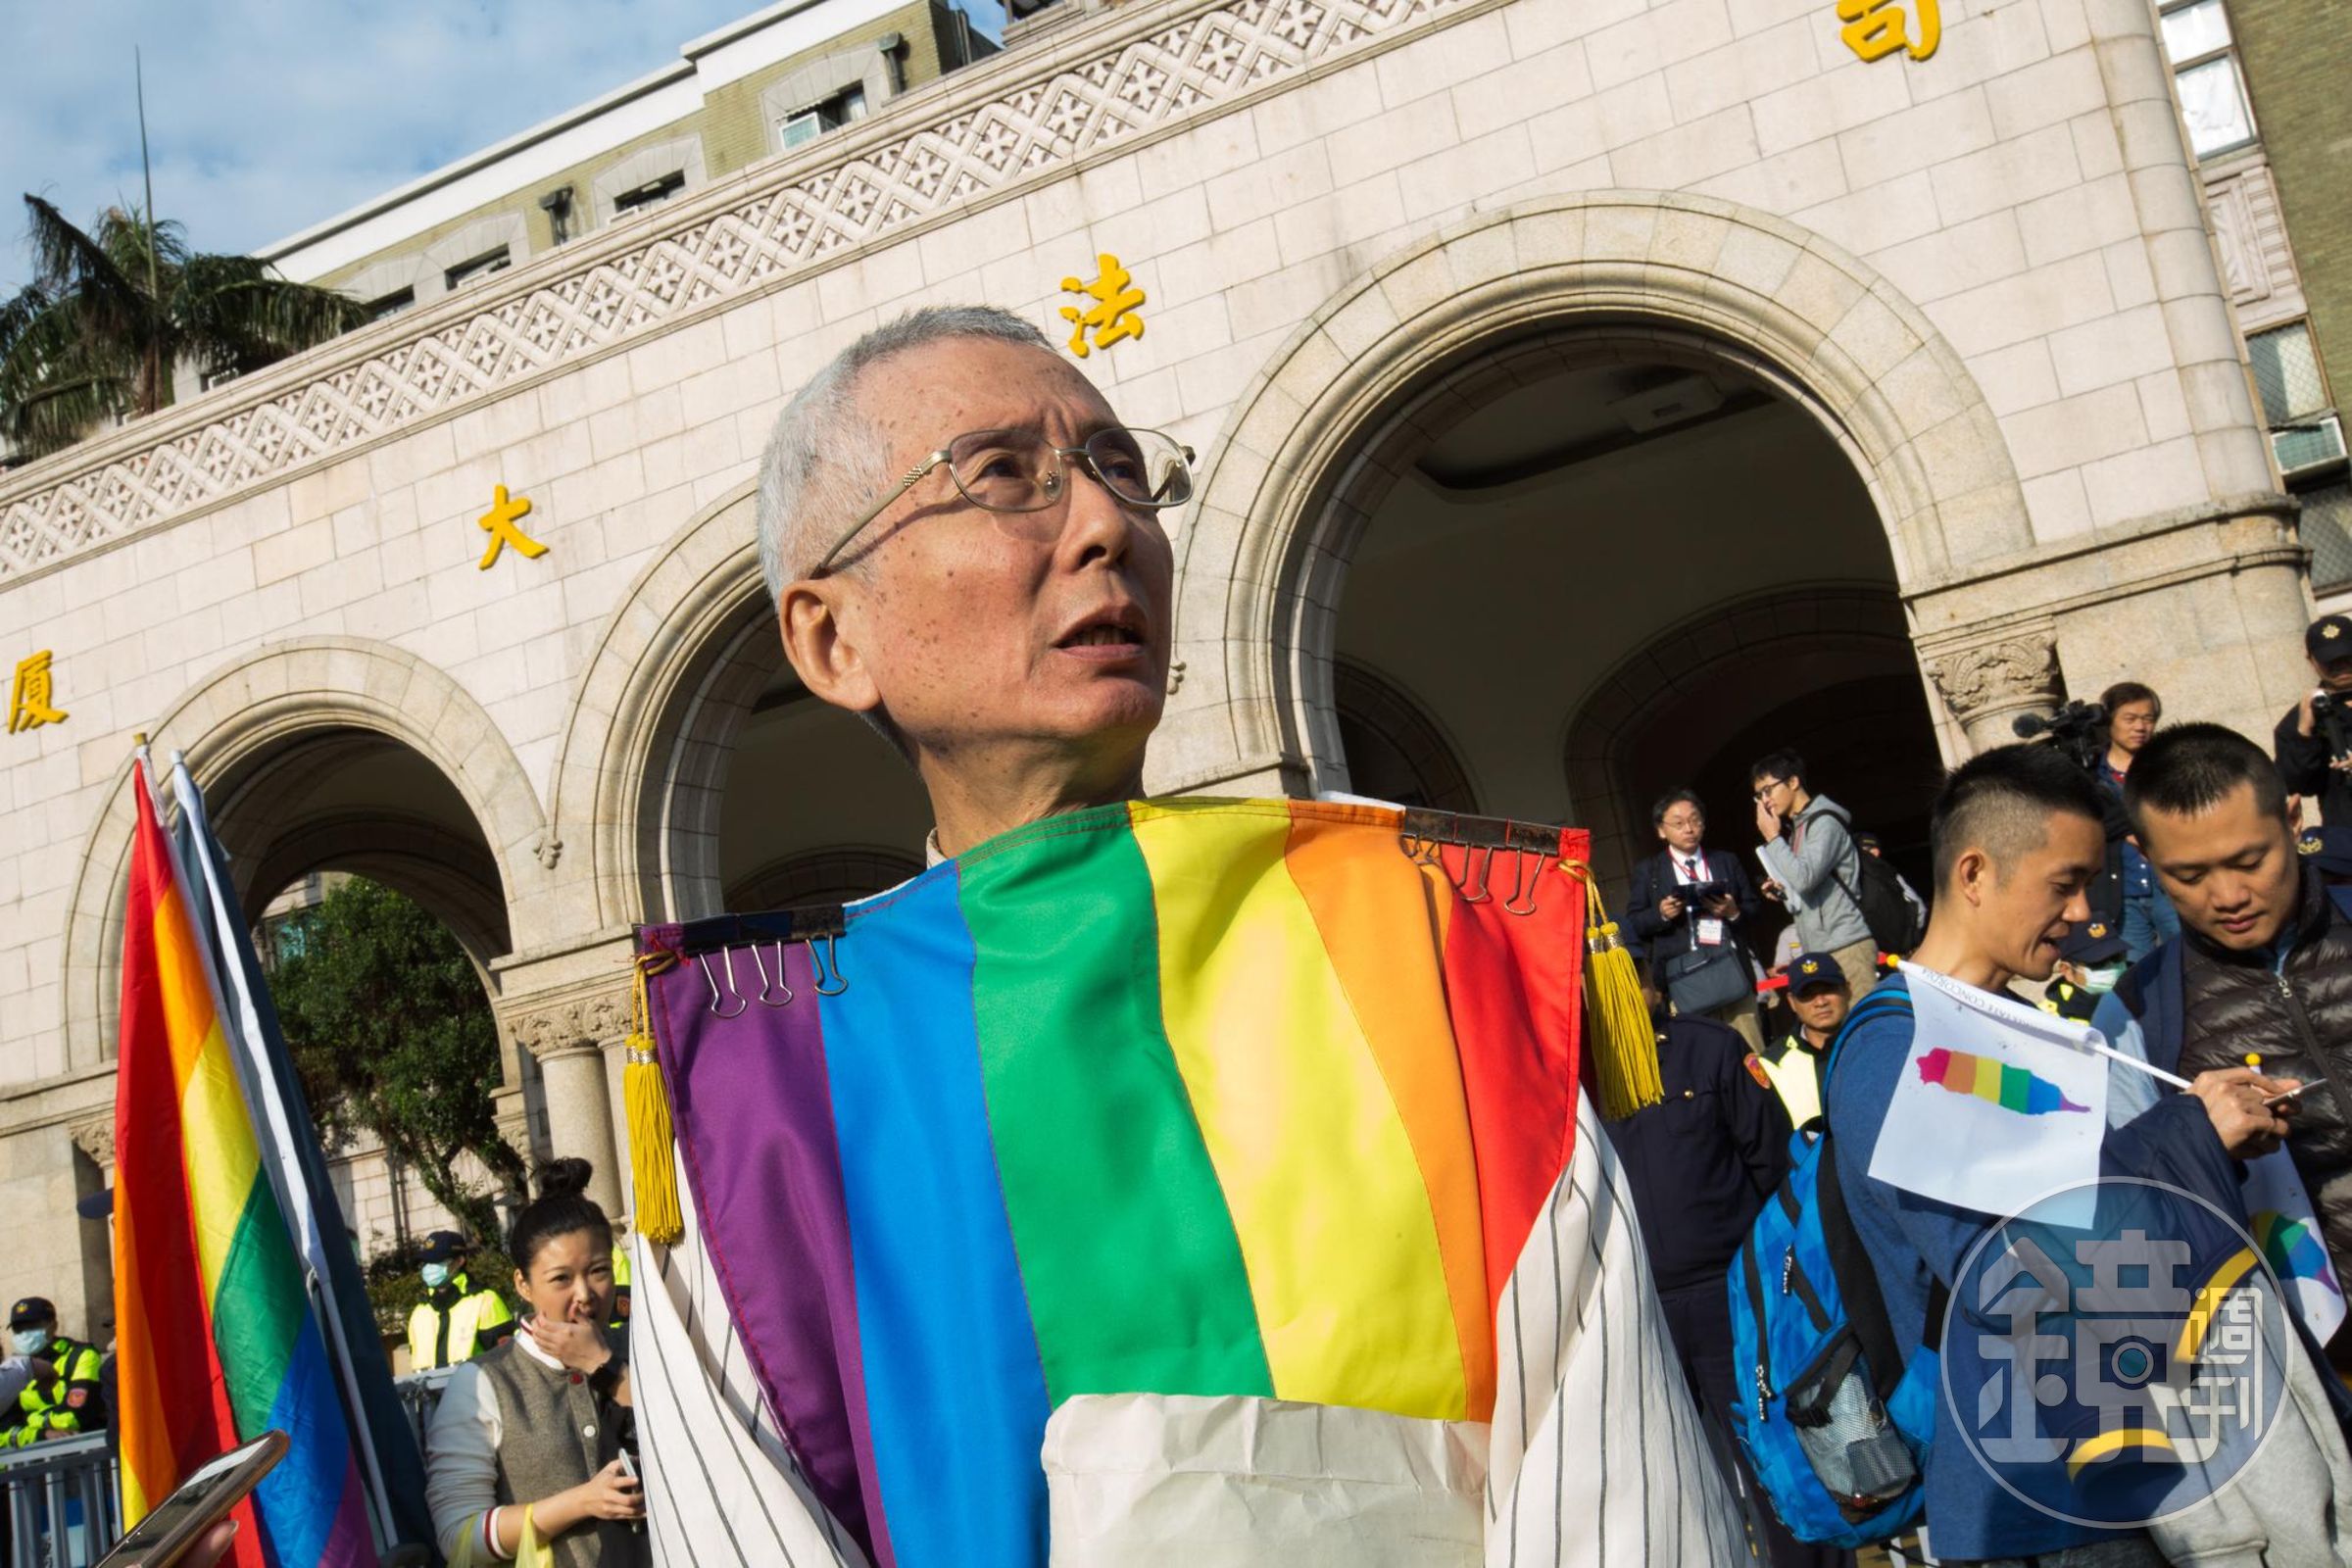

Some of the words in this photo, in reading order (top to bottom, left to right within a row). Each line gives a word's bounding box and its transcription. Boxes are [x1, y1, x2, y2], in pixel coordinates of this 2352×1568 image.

[1837, 0, 1940, 63] 司
[1059, 254, 1146, 358] 法
[478, 484, 550, 571] 大
